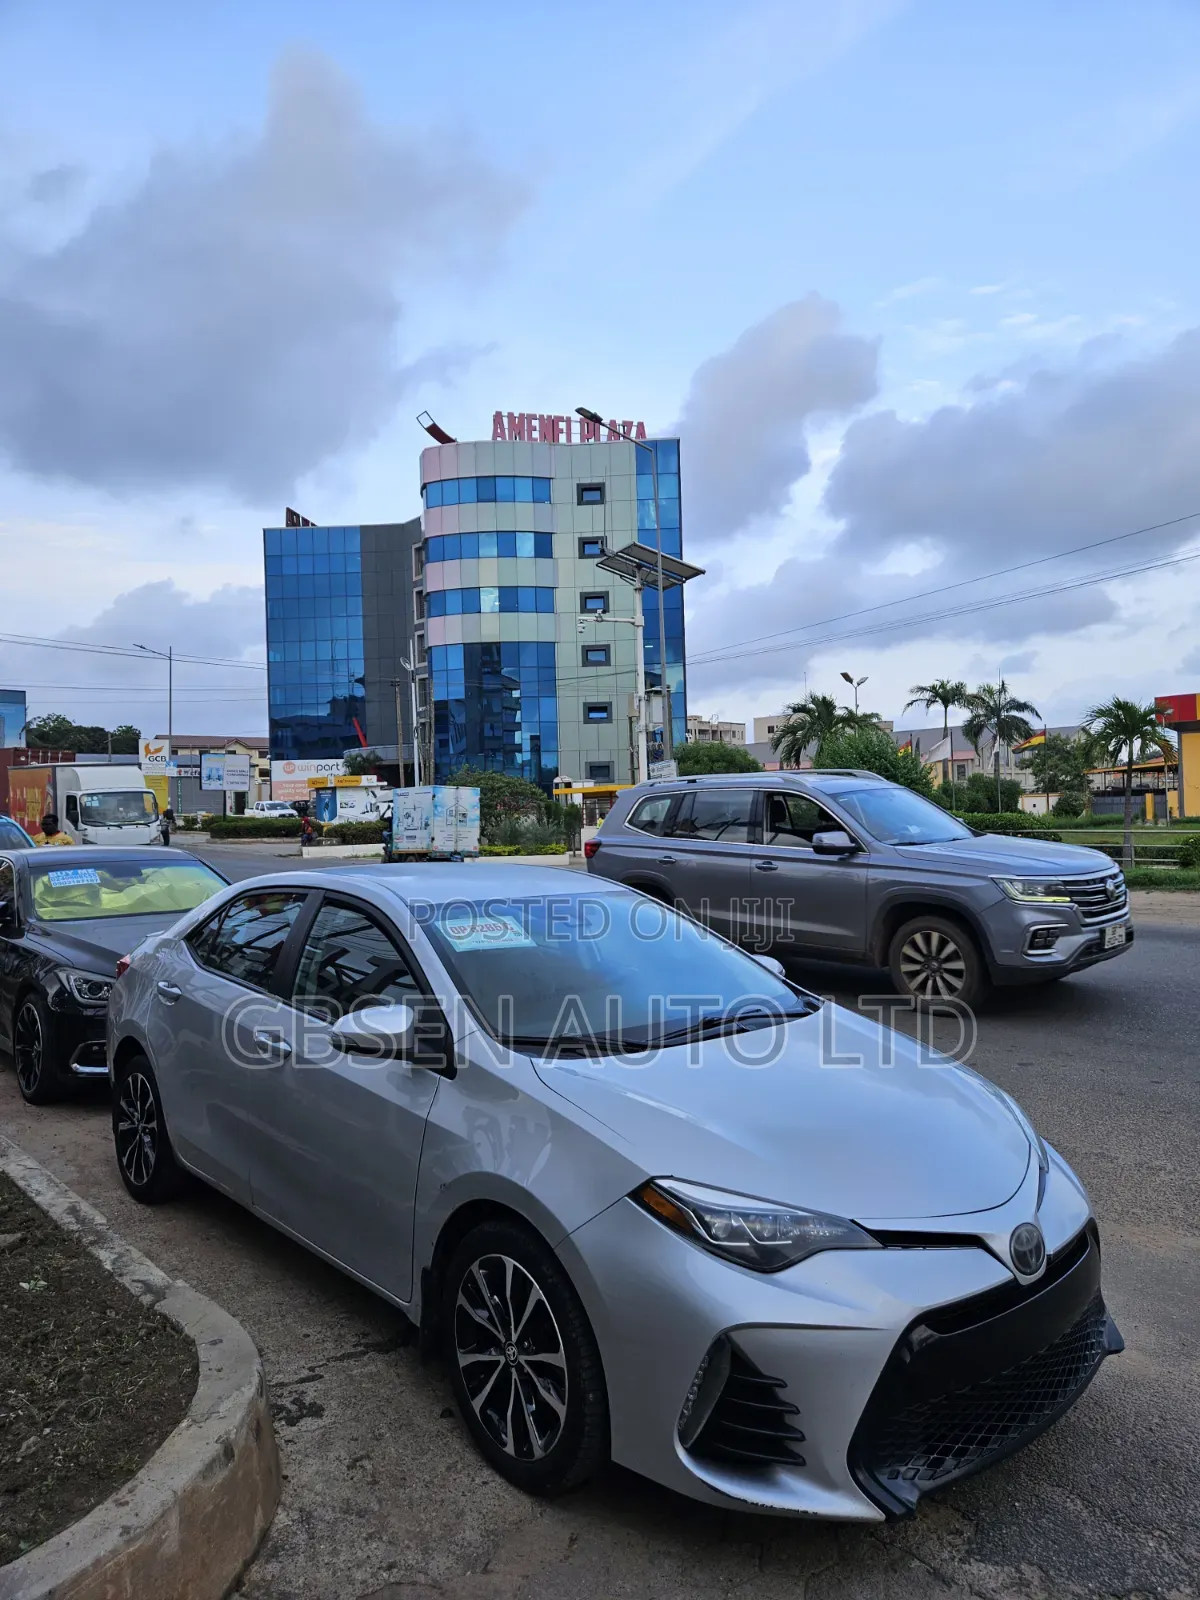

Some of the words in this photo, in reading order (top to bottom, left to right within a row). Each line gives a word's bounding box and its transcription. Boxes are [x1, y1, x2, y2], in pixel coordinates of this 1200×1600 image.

[492, 411, 572, 443] AMENFI
[580, 418, 647, 443] PLAZA
[297, 762, 340, 773] winpart
